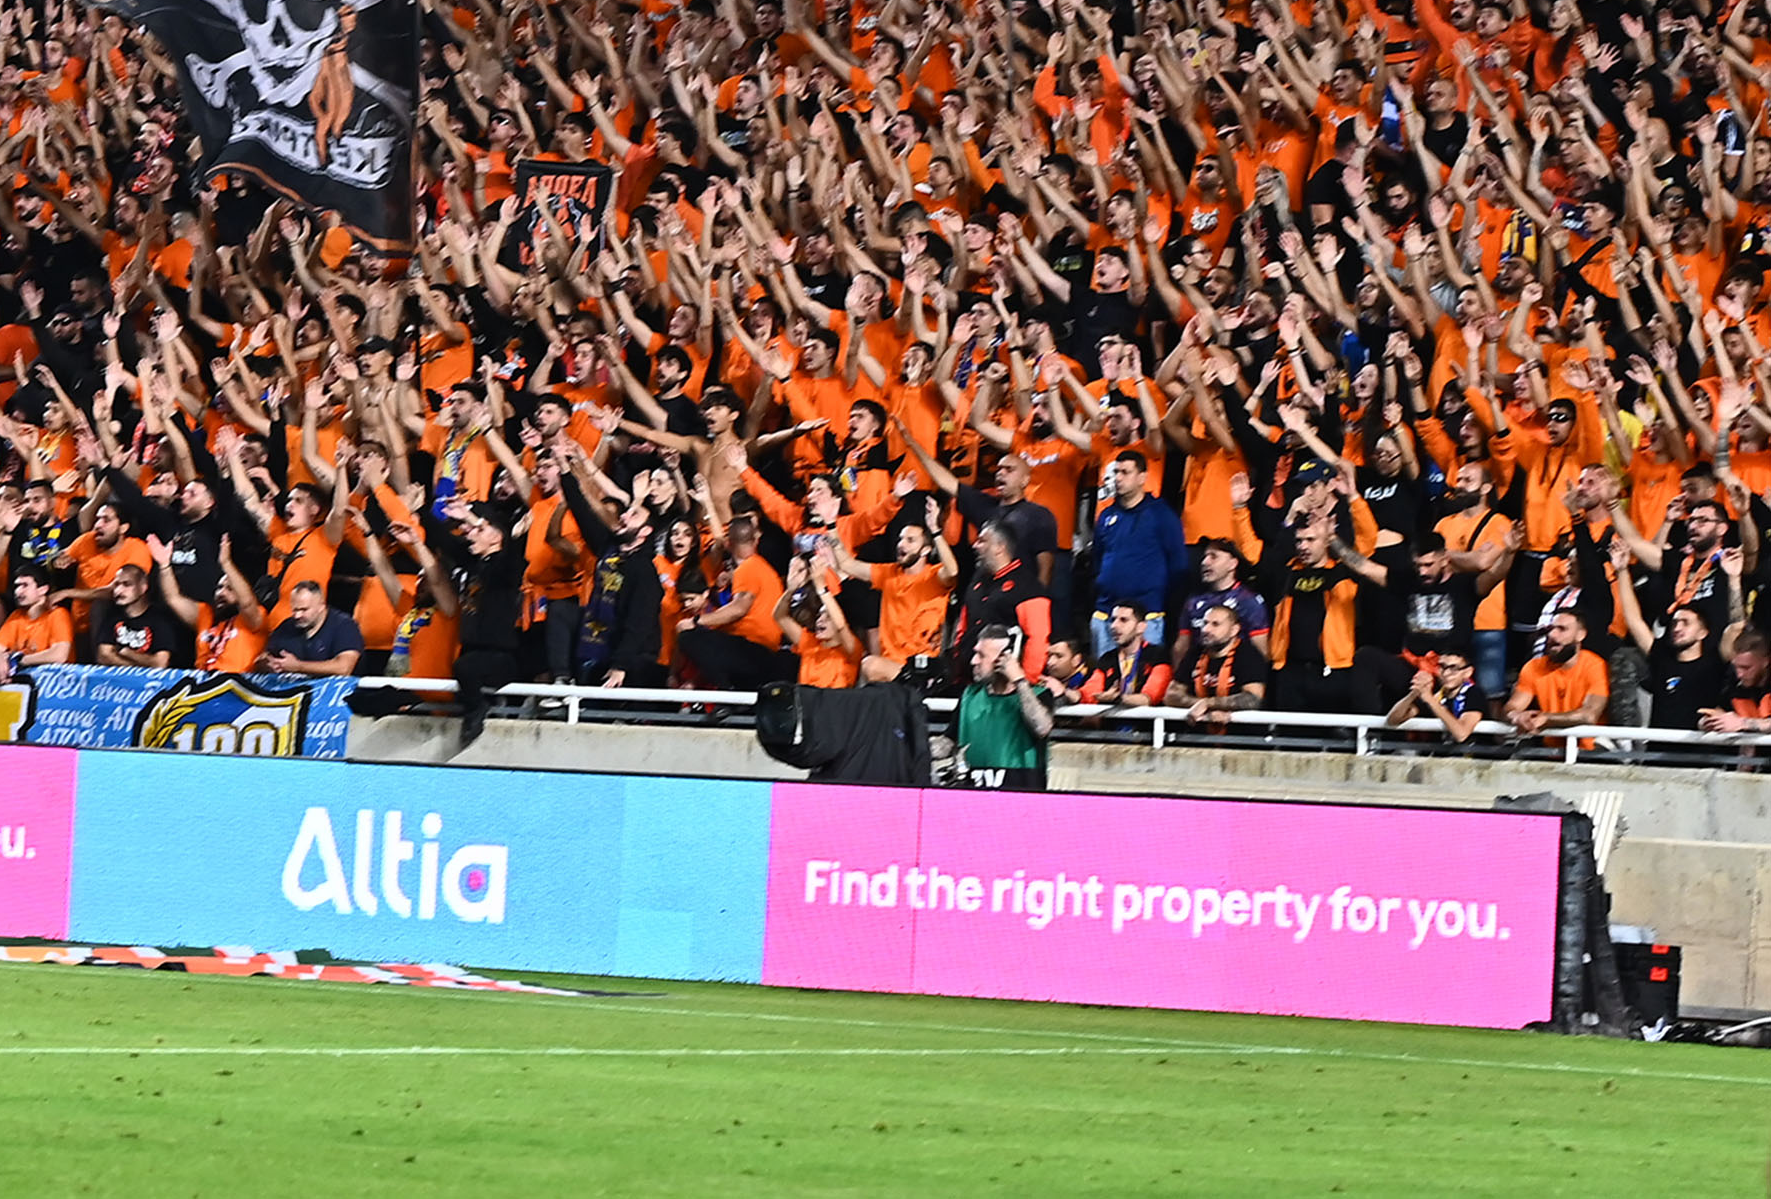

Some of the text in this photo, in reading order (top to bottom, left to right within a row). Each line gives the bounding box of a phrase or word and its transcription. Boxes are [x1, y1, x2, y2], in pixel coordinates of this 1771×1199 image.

[281, 807, 508, 924] Altia
[804, 860, 1512, 951] Find the right property for you.
